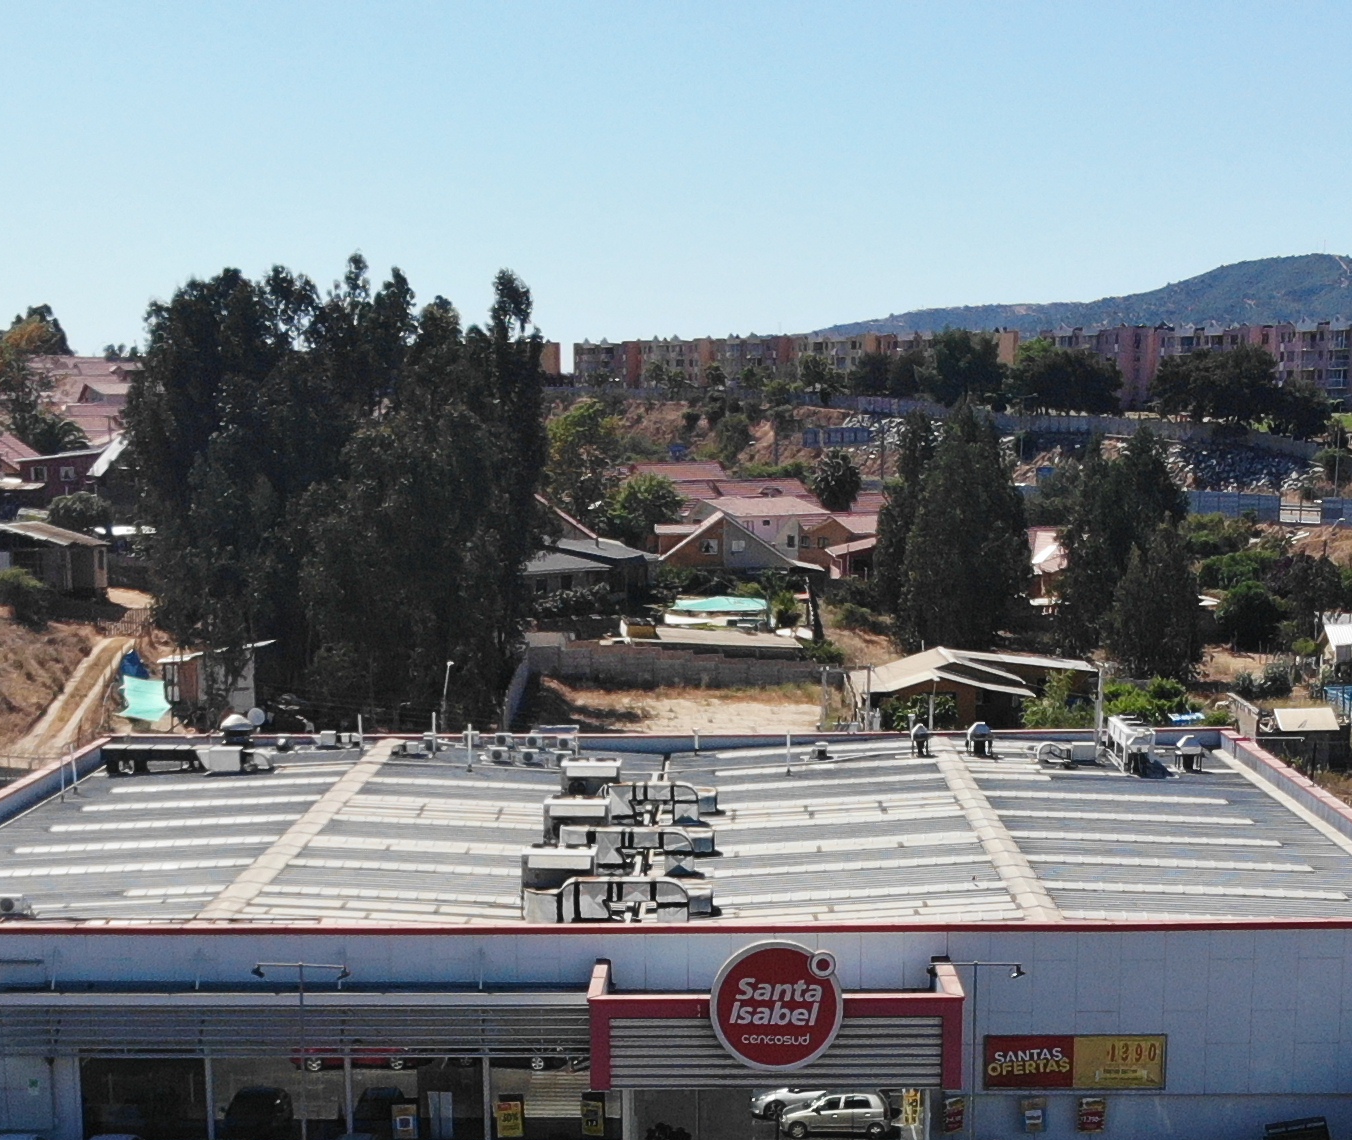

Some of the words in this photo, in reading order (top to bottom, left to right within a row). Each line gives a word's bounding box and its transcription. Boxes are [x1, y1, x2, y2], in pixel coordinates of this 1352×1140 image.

[735, 977, 823, 1002] Santa
[729, 1001, 820, 1026] Isabel
[741, 1033, 810, 1045] cencosud
[994, 1047, 1064, 1063] SANTAS
[987, 1057, 1070, 1077] OFERTAS
